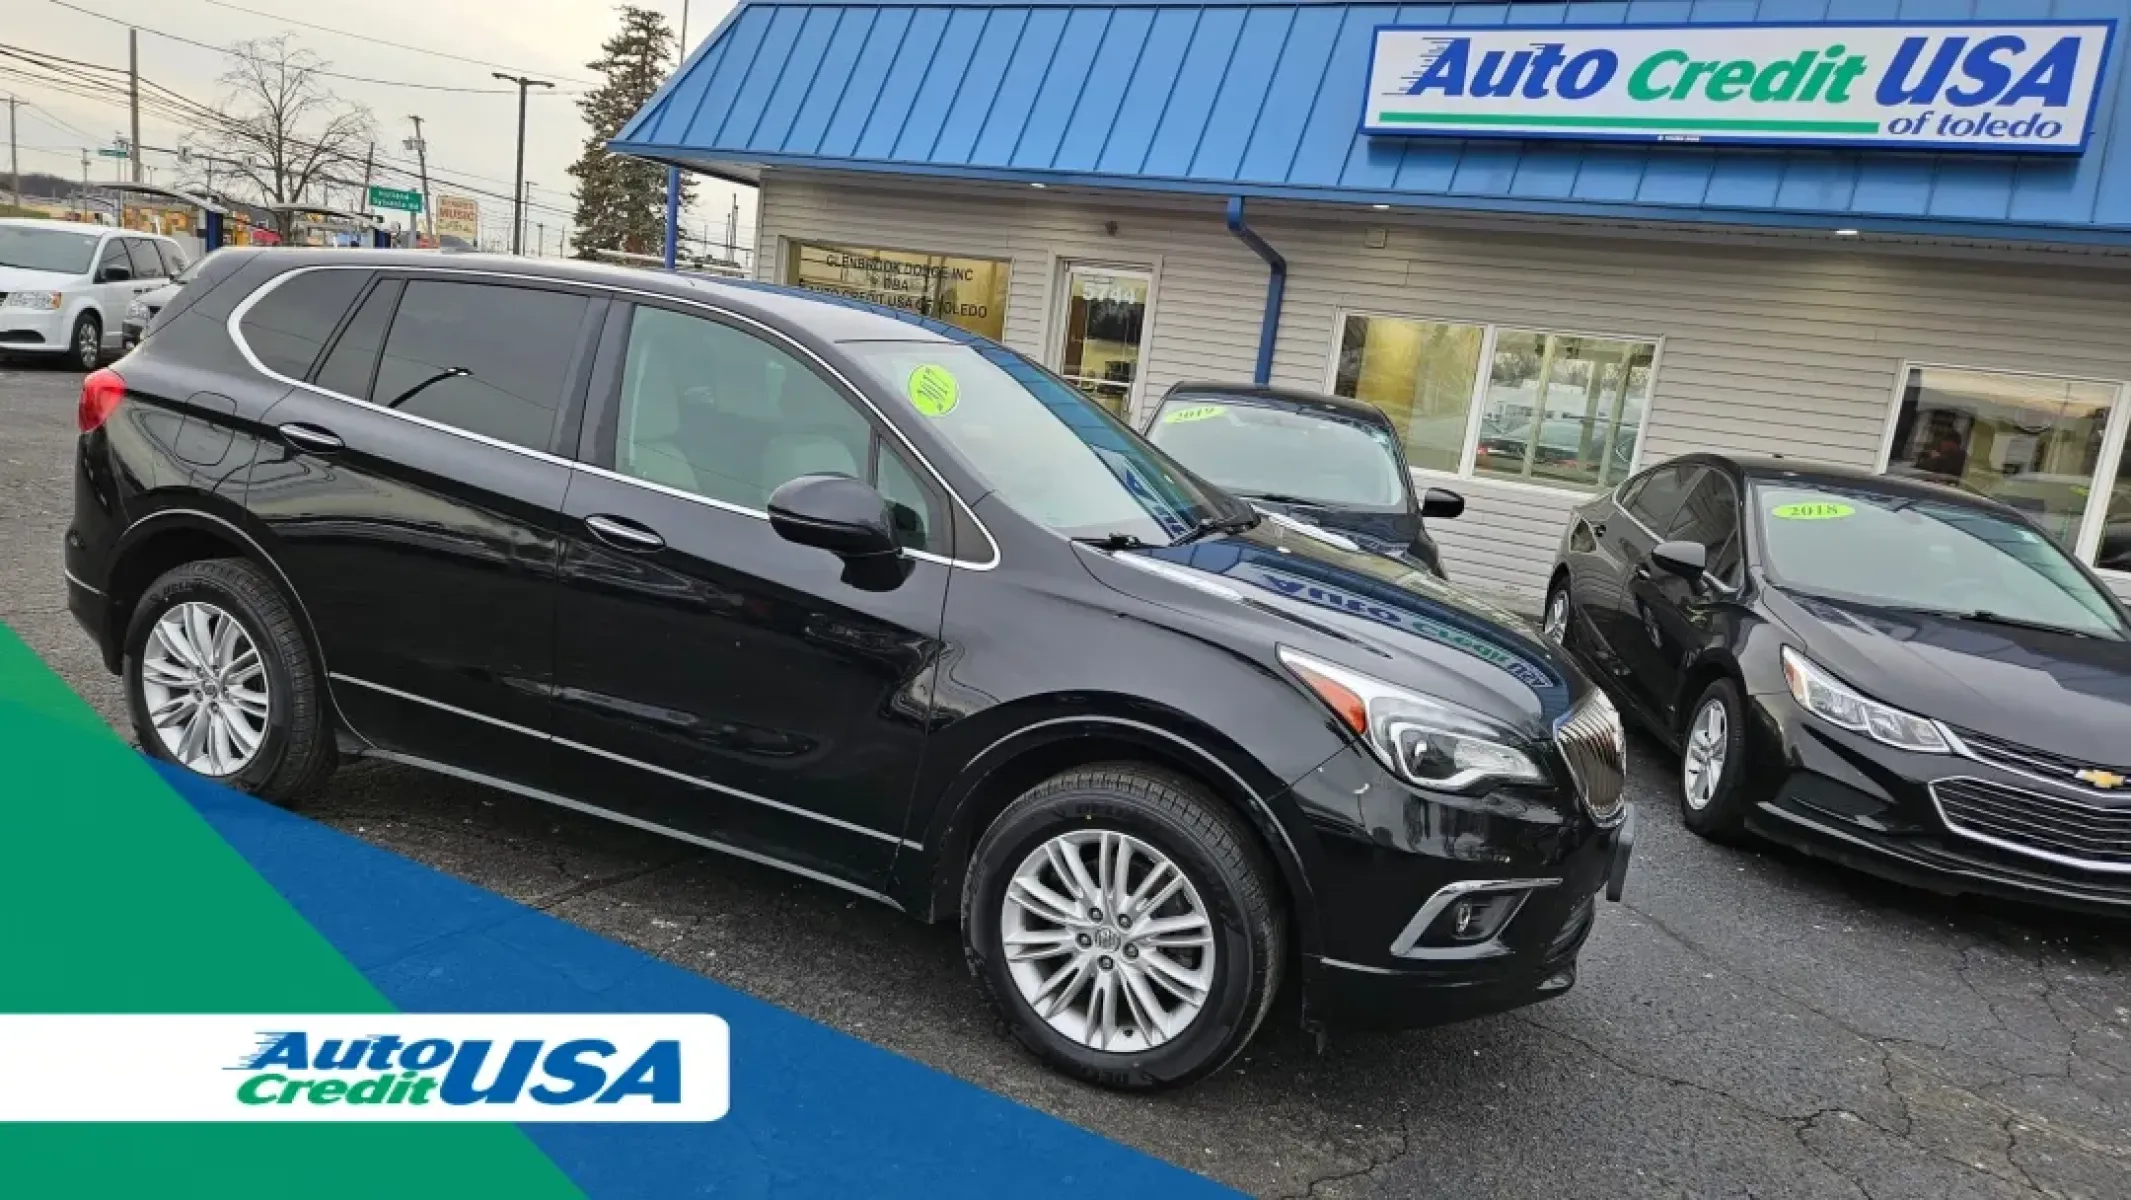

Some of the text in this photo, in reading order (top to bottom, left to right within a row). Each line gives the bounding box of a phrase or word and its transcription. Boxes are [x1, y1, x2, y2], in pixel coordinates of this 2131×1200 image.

[1388, 35, 2082, 107] Auto Credit USA
[1887, 110, 2063, 139] of toledo
[952, 267, 974, 281] INC
[1790, 504, 1838, 516] 2018
